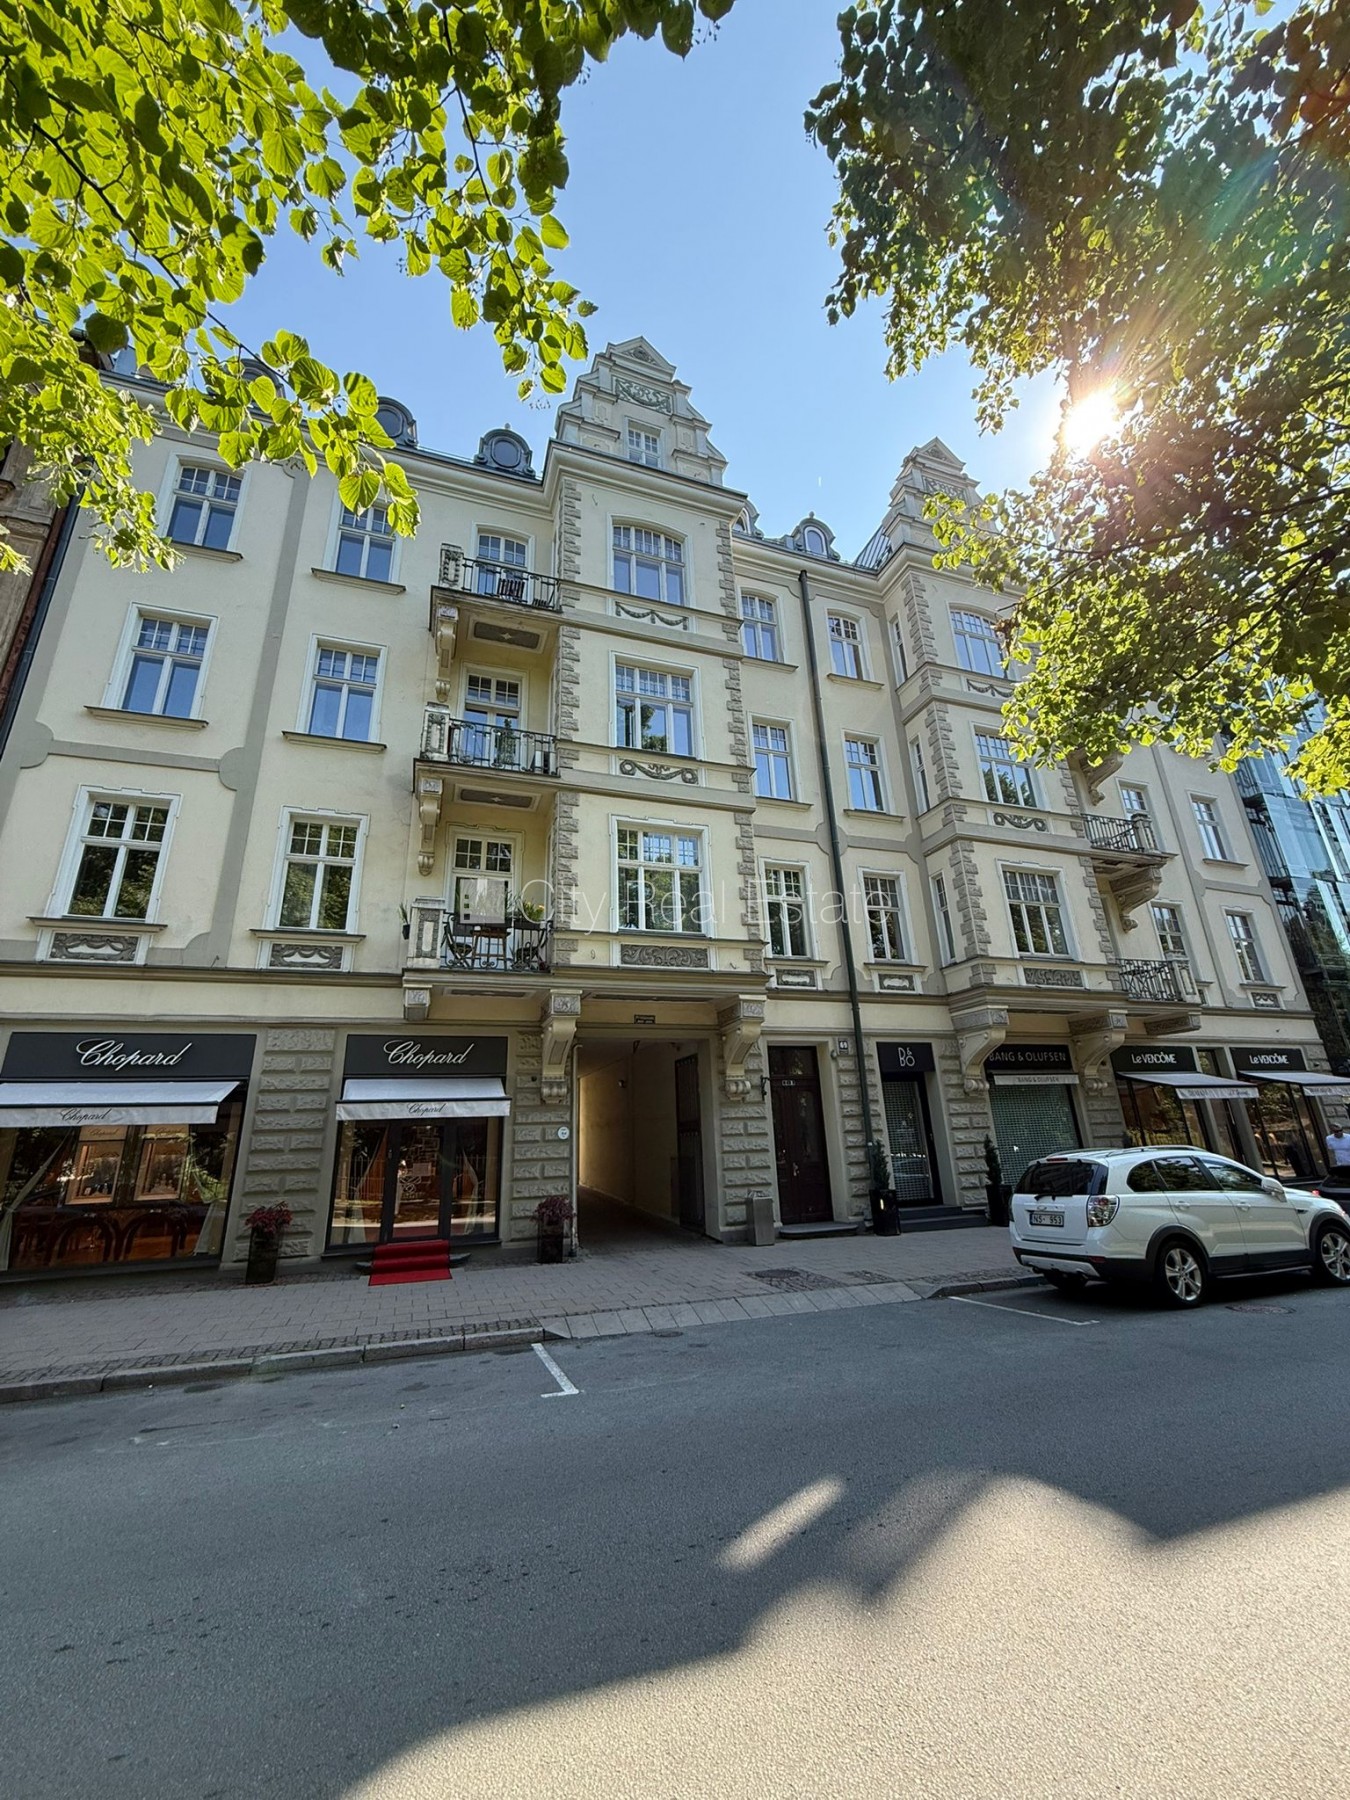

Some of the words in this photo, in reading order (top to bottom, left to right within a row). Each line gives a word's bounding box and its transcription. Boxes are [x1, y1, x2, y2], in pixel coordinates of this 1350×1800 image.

[76, 1039, 192, 1071] Chopard
[383, 1040, 474, 1069] Chopard
[989, 1051, 1015, 1062] BANG
[1017, 1051, 1024, 1062] &
[1025, 1051, 1066, 1062] OLUFSEN
[60, 1107, 112, 1124] Chopard
[406, 1103, 447, 1117] Chopard
